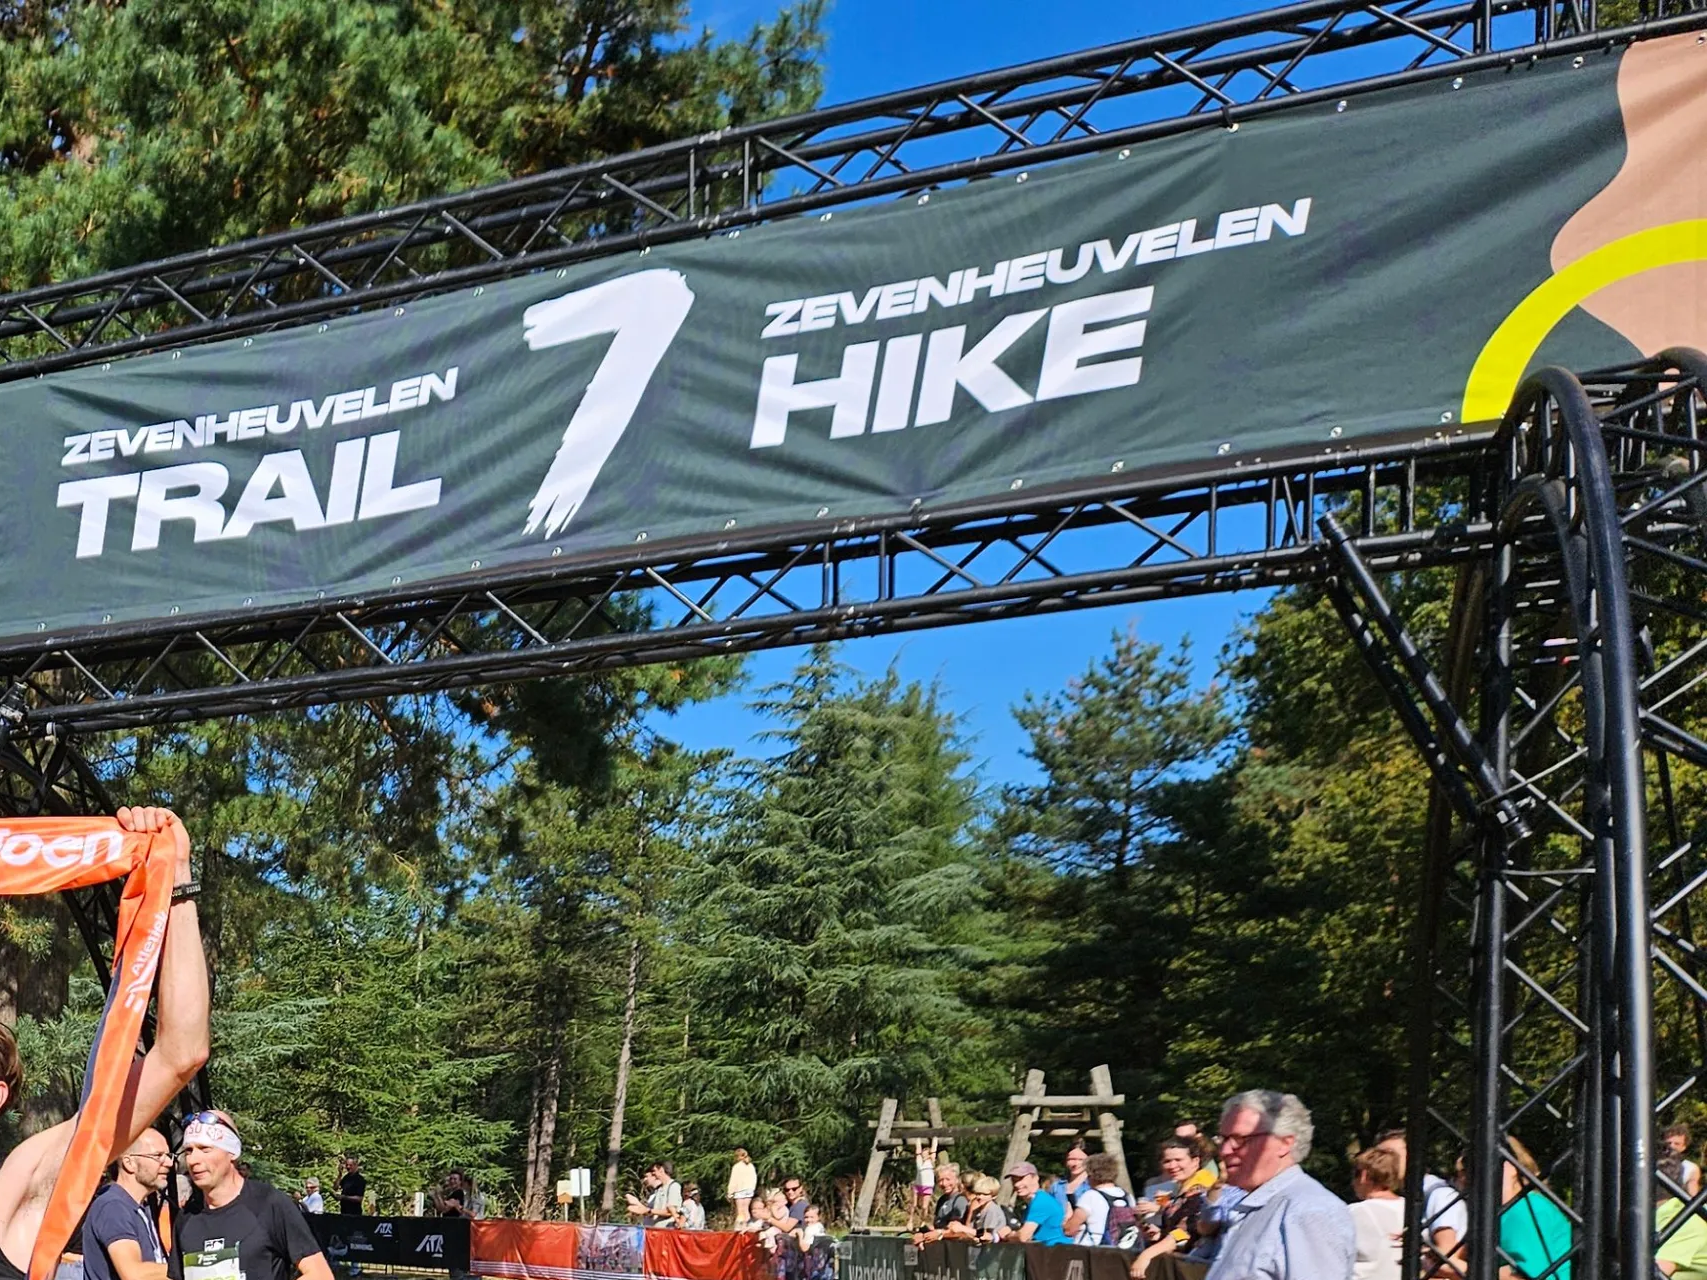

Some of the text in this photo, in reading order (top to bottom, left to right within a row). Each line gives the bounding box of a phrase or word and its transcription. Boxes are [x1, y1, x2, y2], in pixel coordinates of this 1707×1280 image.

[761, 197, 1312, 340] ZEVENHEUVELEN
[61, 366, 459, 467] ZEVENHEUVELEN
[523, 268, 694, 541] 7
[749, 285, 1155, 449] HIKE
[56, 430, 442, 560] TRAIL
